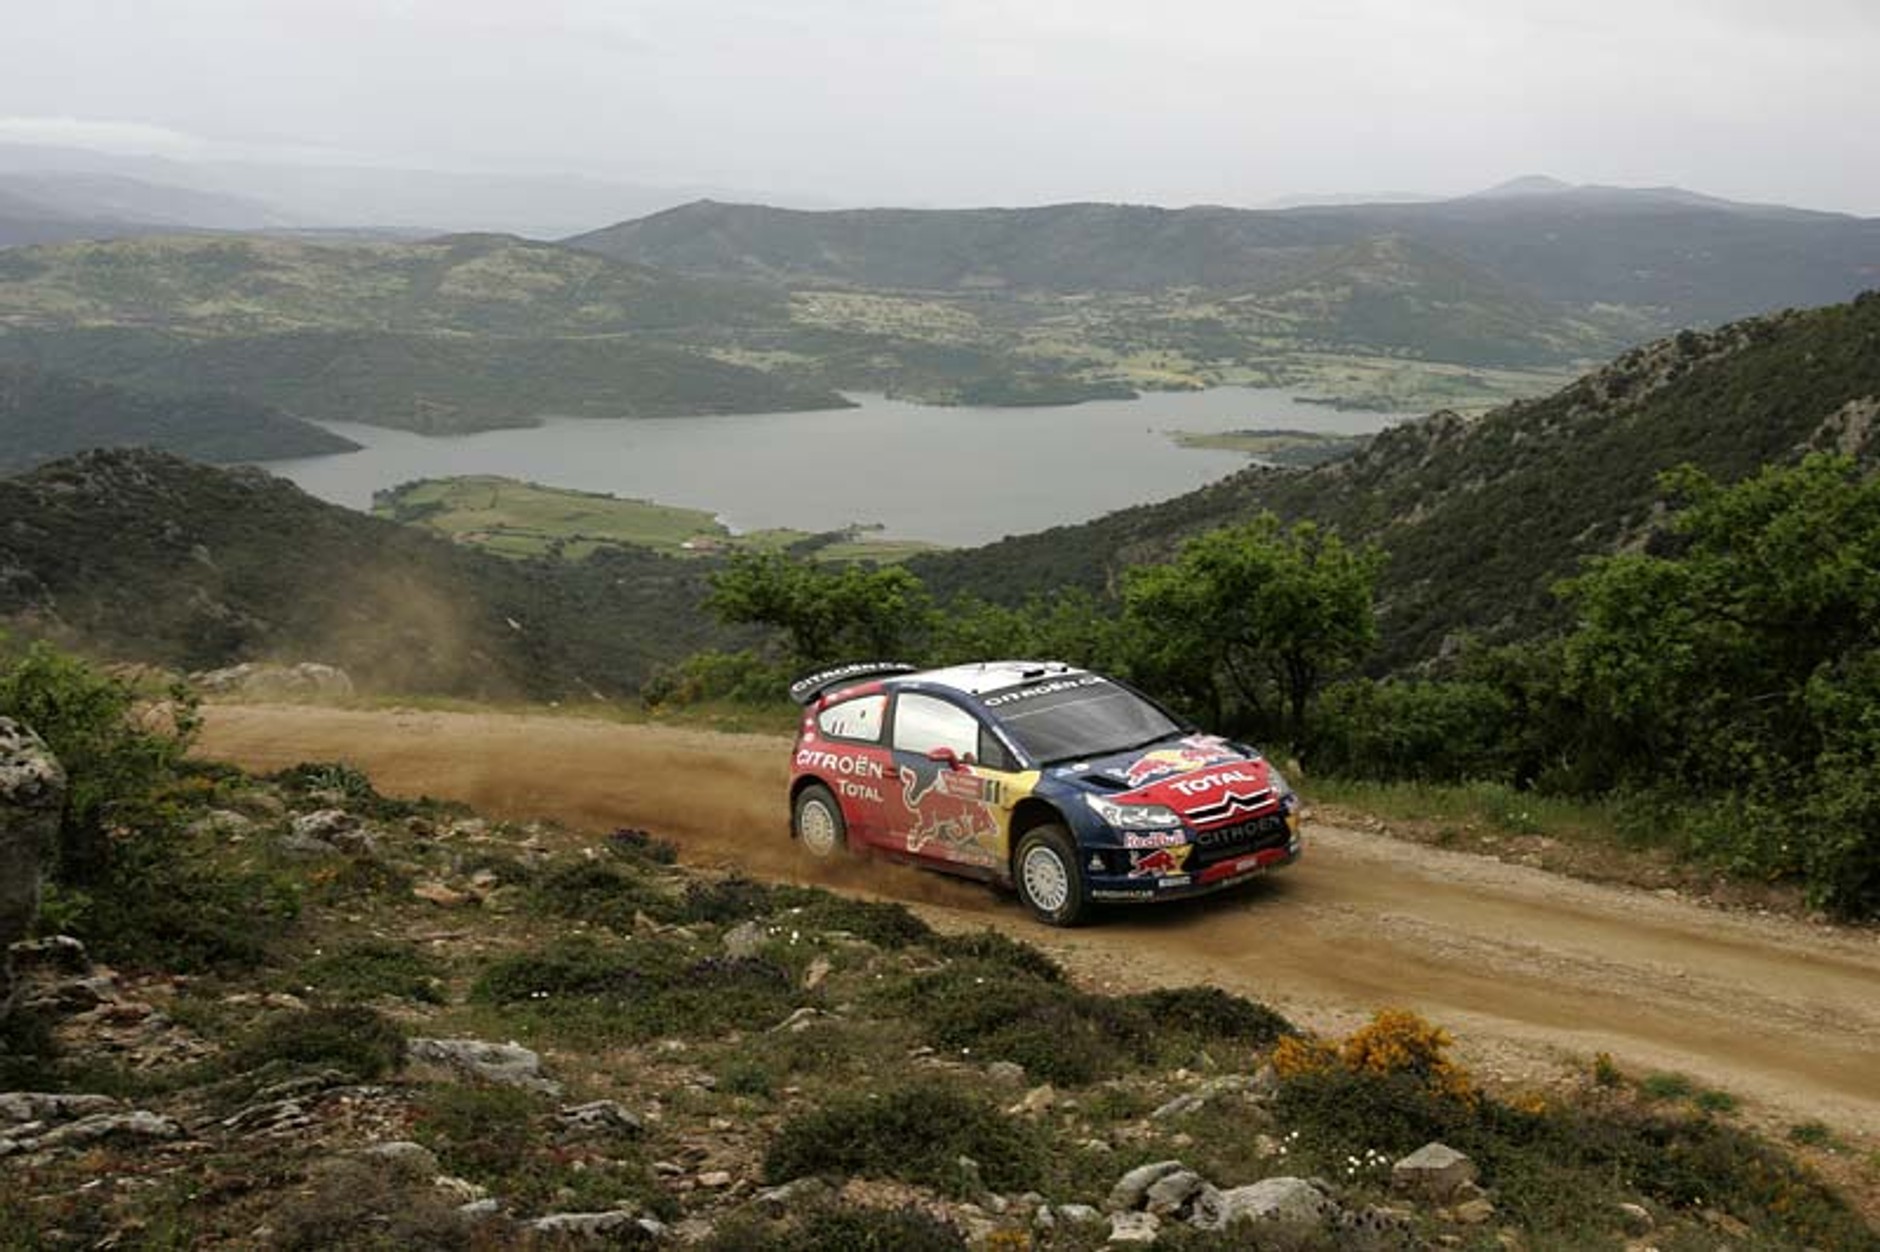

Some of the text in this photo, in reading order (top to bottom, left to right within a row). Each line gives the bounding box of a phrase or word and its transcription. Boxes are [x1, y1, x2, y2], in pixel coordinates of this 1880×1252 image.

[796, 749, 883, 779] CITROËN
[836, 779, 884, 803] TOTAL
[1168, 770, 1257, 796] TOTAL
